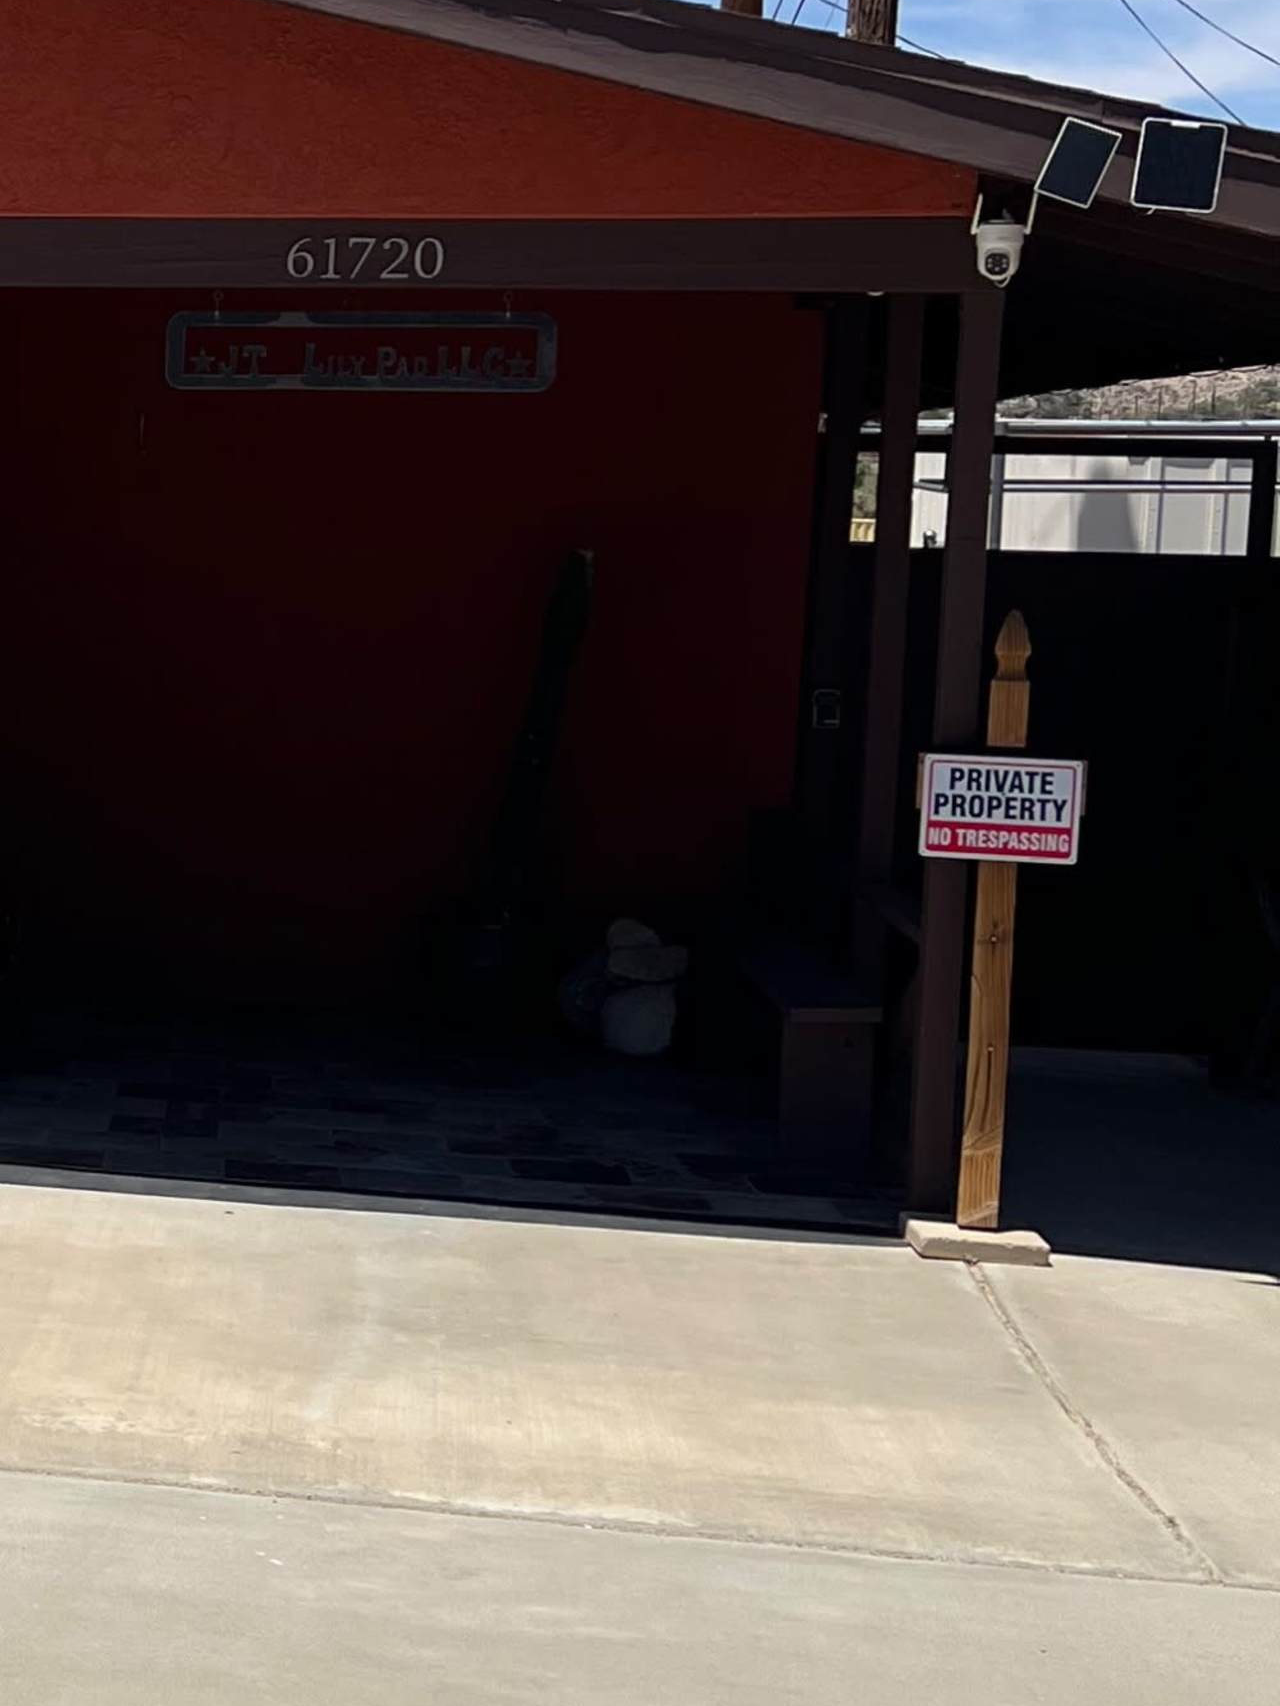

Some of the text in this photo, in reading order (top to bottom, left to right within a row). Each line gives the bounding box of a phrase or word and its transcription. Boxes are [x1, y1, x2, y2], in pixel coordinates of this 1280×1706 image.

[286, 236, 445, 280] 61720
[438, 345, 505, 378] LLC
[949, 767, 1055, 795] PRIVATE
[933, 793, 1068, 822] PROPERTY
[928, 827, 1070, 853] NO TRESPASSING
